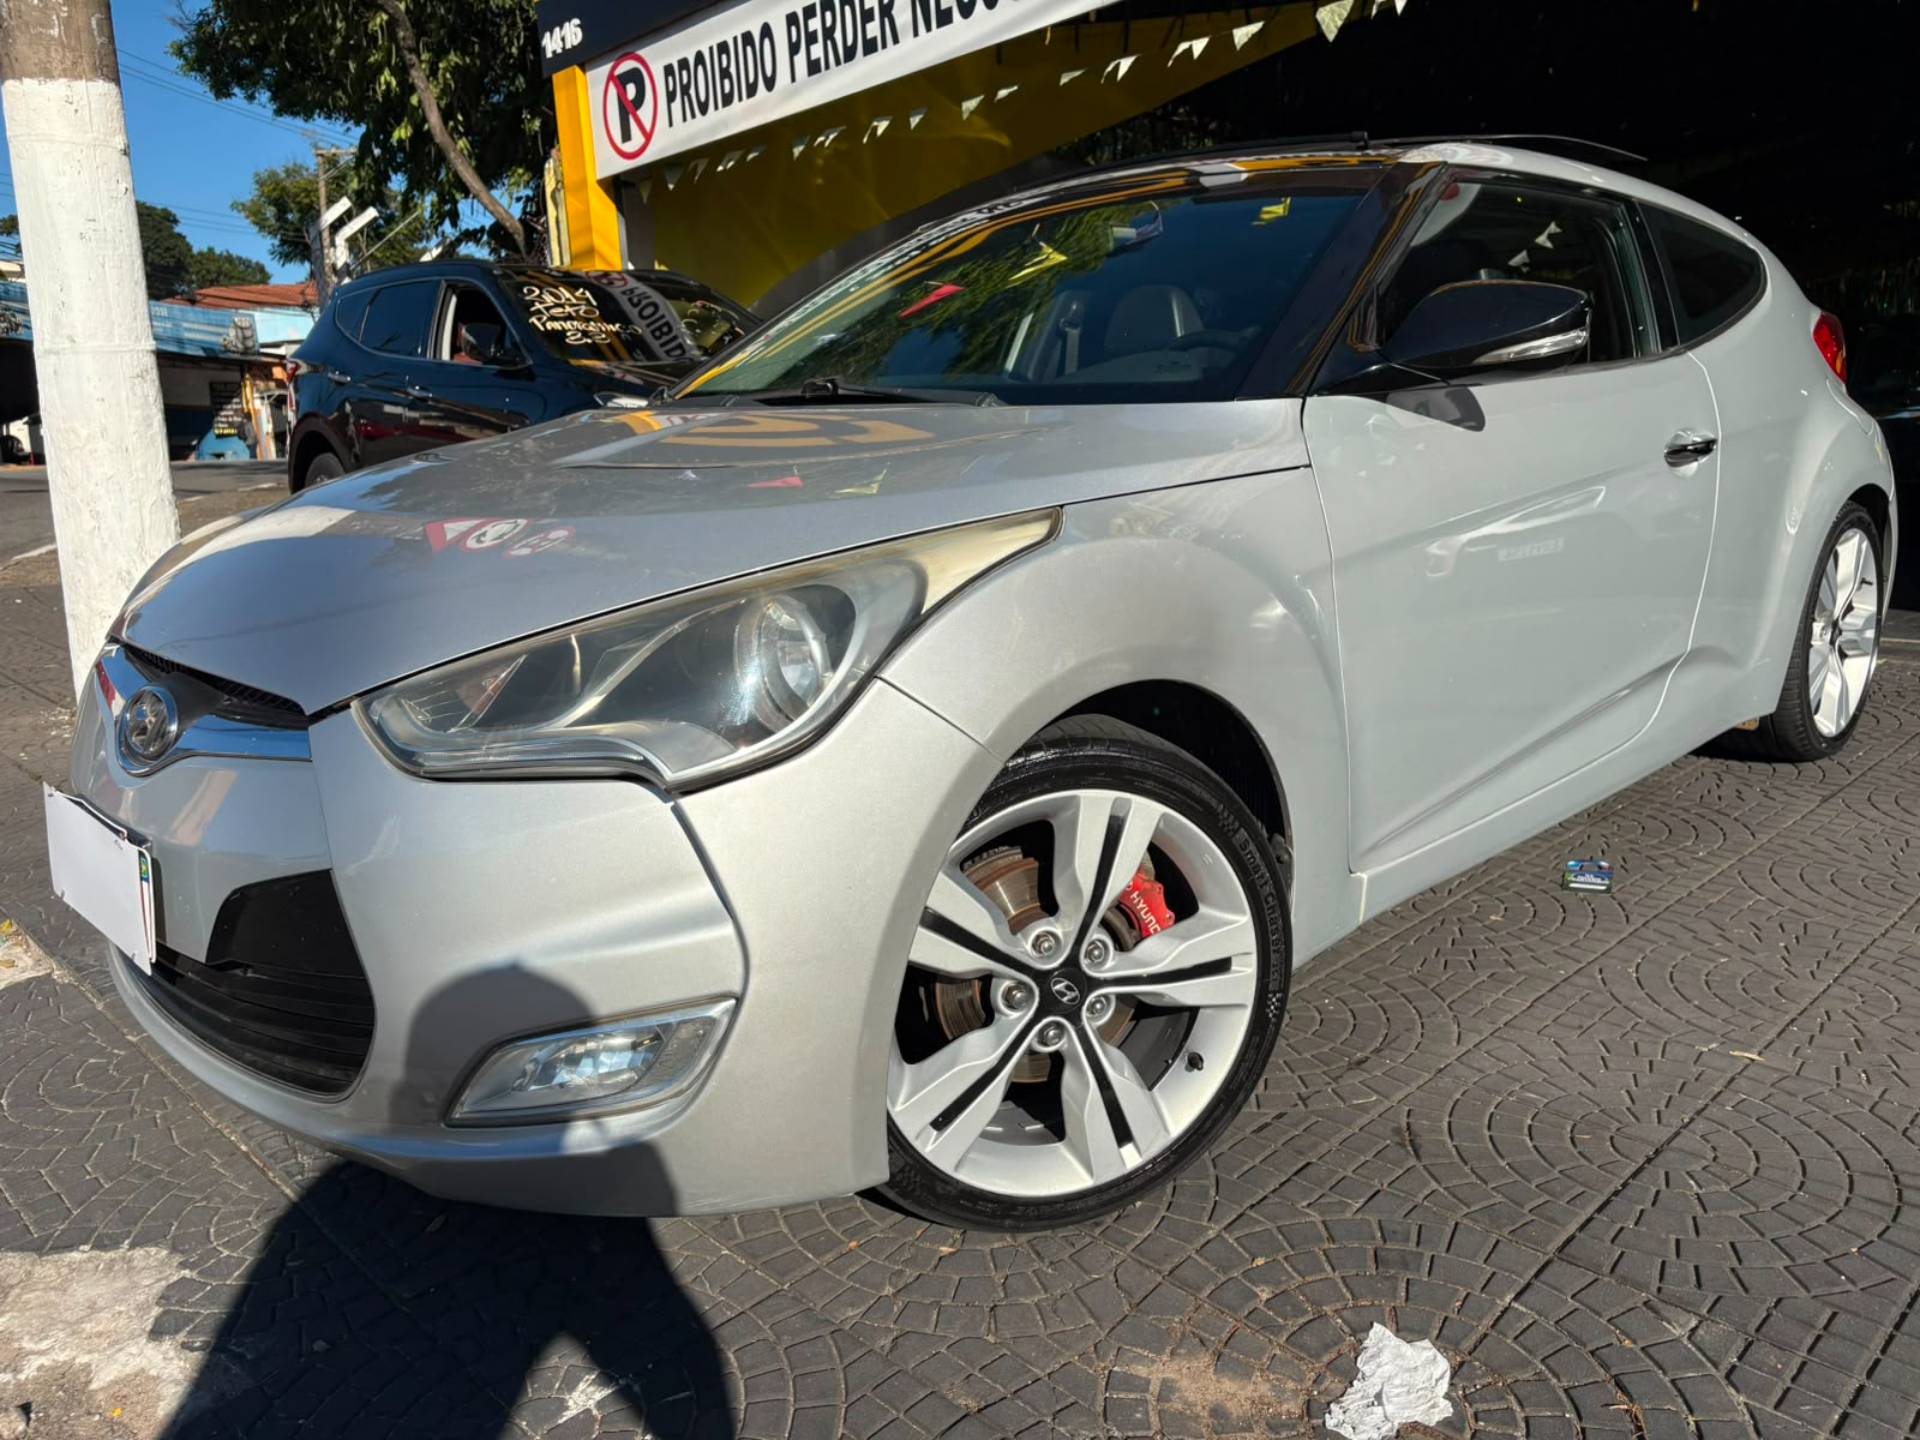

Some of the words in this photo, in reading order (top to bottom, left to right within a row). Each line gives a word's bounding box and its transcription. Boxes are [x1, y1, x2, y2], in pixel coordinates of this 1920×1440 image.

[541, 18, 583, 58] 1416
[663, 21, 777, 128] PROIBIDO
[786, 0, 900, 83] PERDER
[523, 286, 597, 306] 2014
[1239, 837, 1272, 889] Smart
[1263, 893, 1283, 956] Chaser
